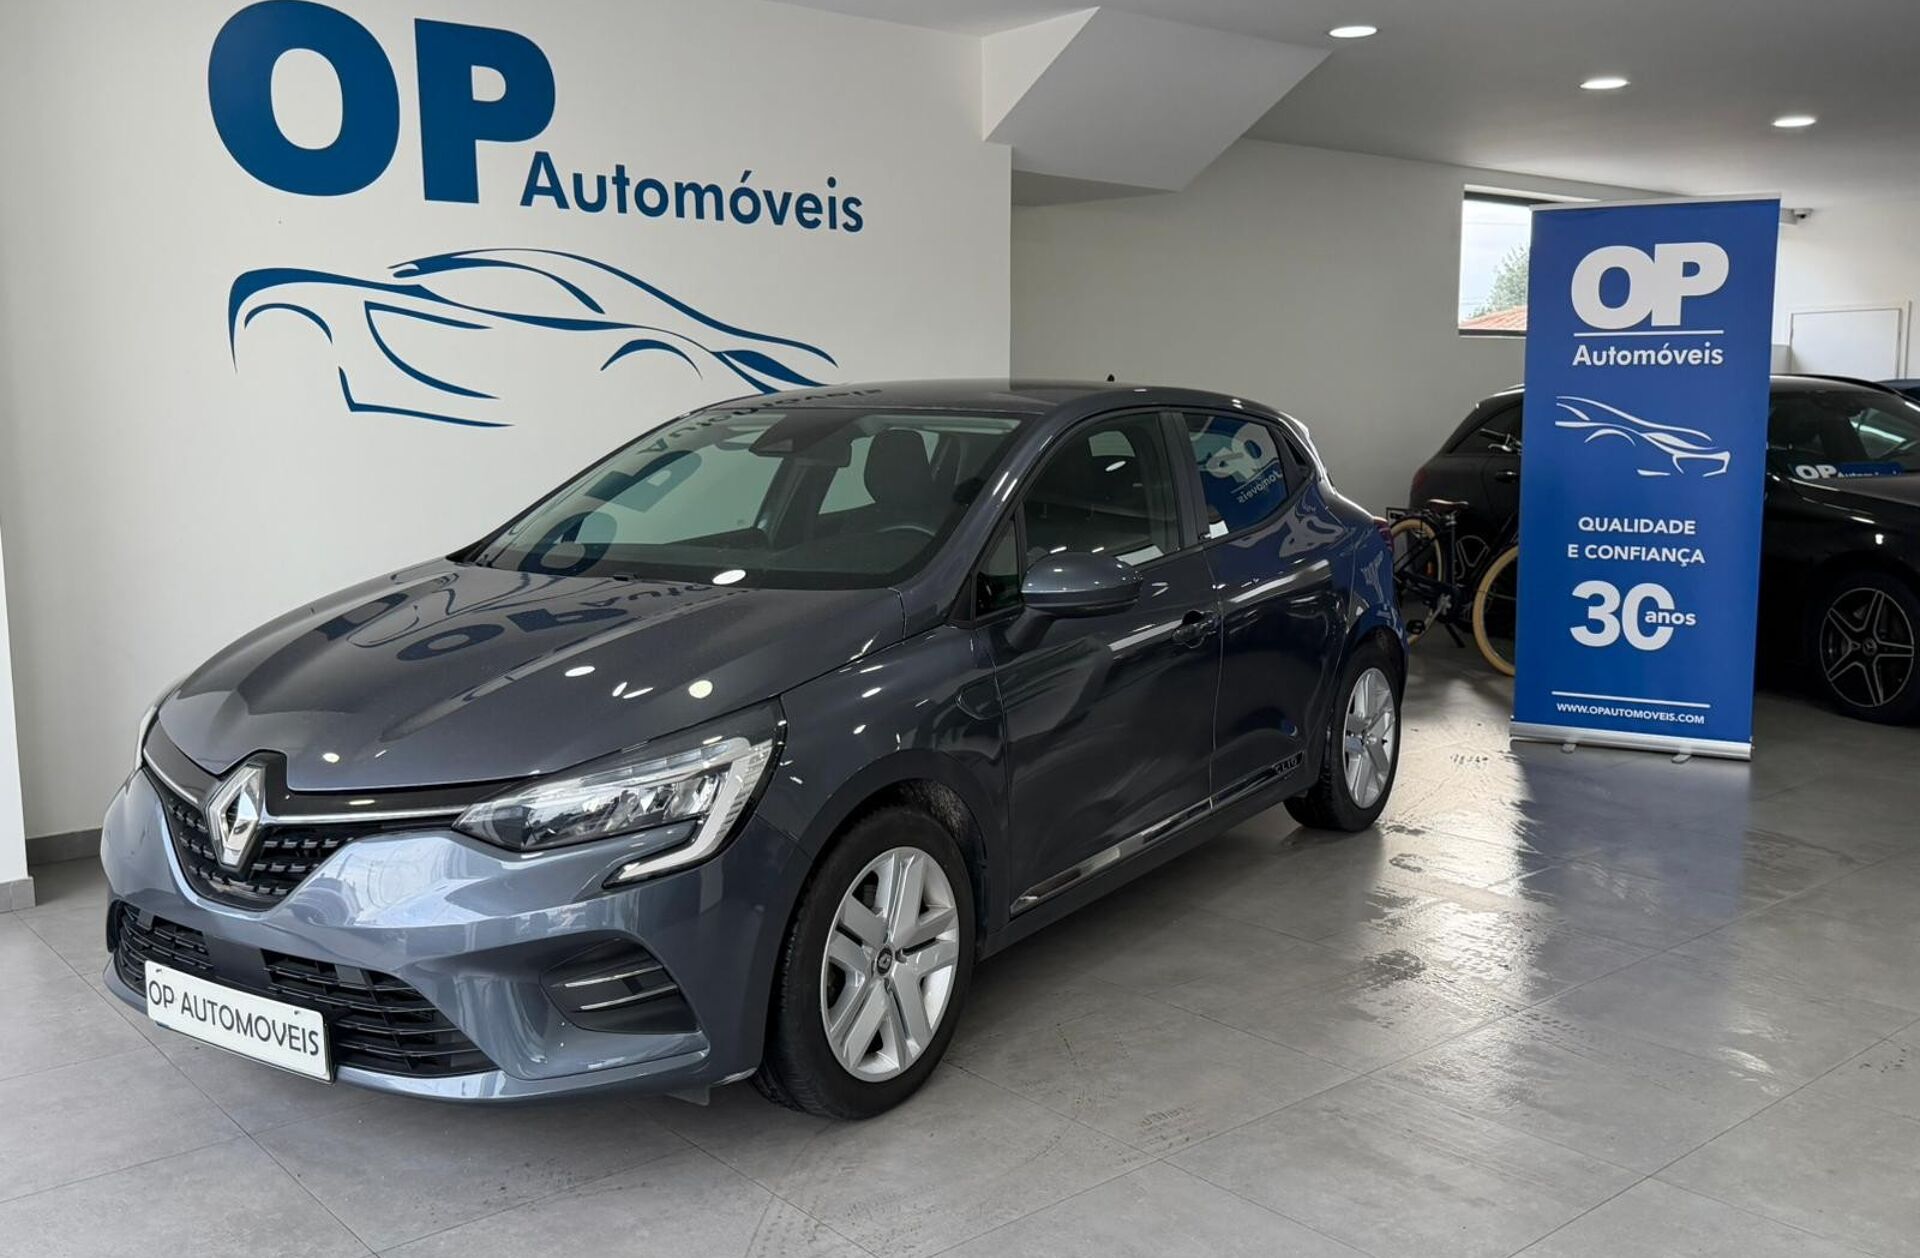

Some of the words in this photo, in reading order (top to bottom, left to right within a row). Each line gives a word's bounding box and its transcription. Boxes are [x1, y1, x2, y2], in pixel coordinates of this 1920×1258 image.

[208, 0, 556, 204] OP
[519, 150, 864, 233] Automóveis
[1571, 241, 1730, 330] OP
[1572, 341, 1724, 366] Automóveis
[1795, 464, 1838, 479] OP
[1578, 516, 1696, 535] QUALIDADE
[1567, 543, 1579, 558] E
[1585, 545, 1705, 567] CONFIANÇA
[1570, 580, 1675, 651] 30
[1644, 611, 1697, 626] anos
[1556, 703, 1705, 724] WWW.OPAUTOMOVEIS.COM
[149, 980, 175, 1008] OP
[181, 991, 319, 1056] AUTOMOVEIS
